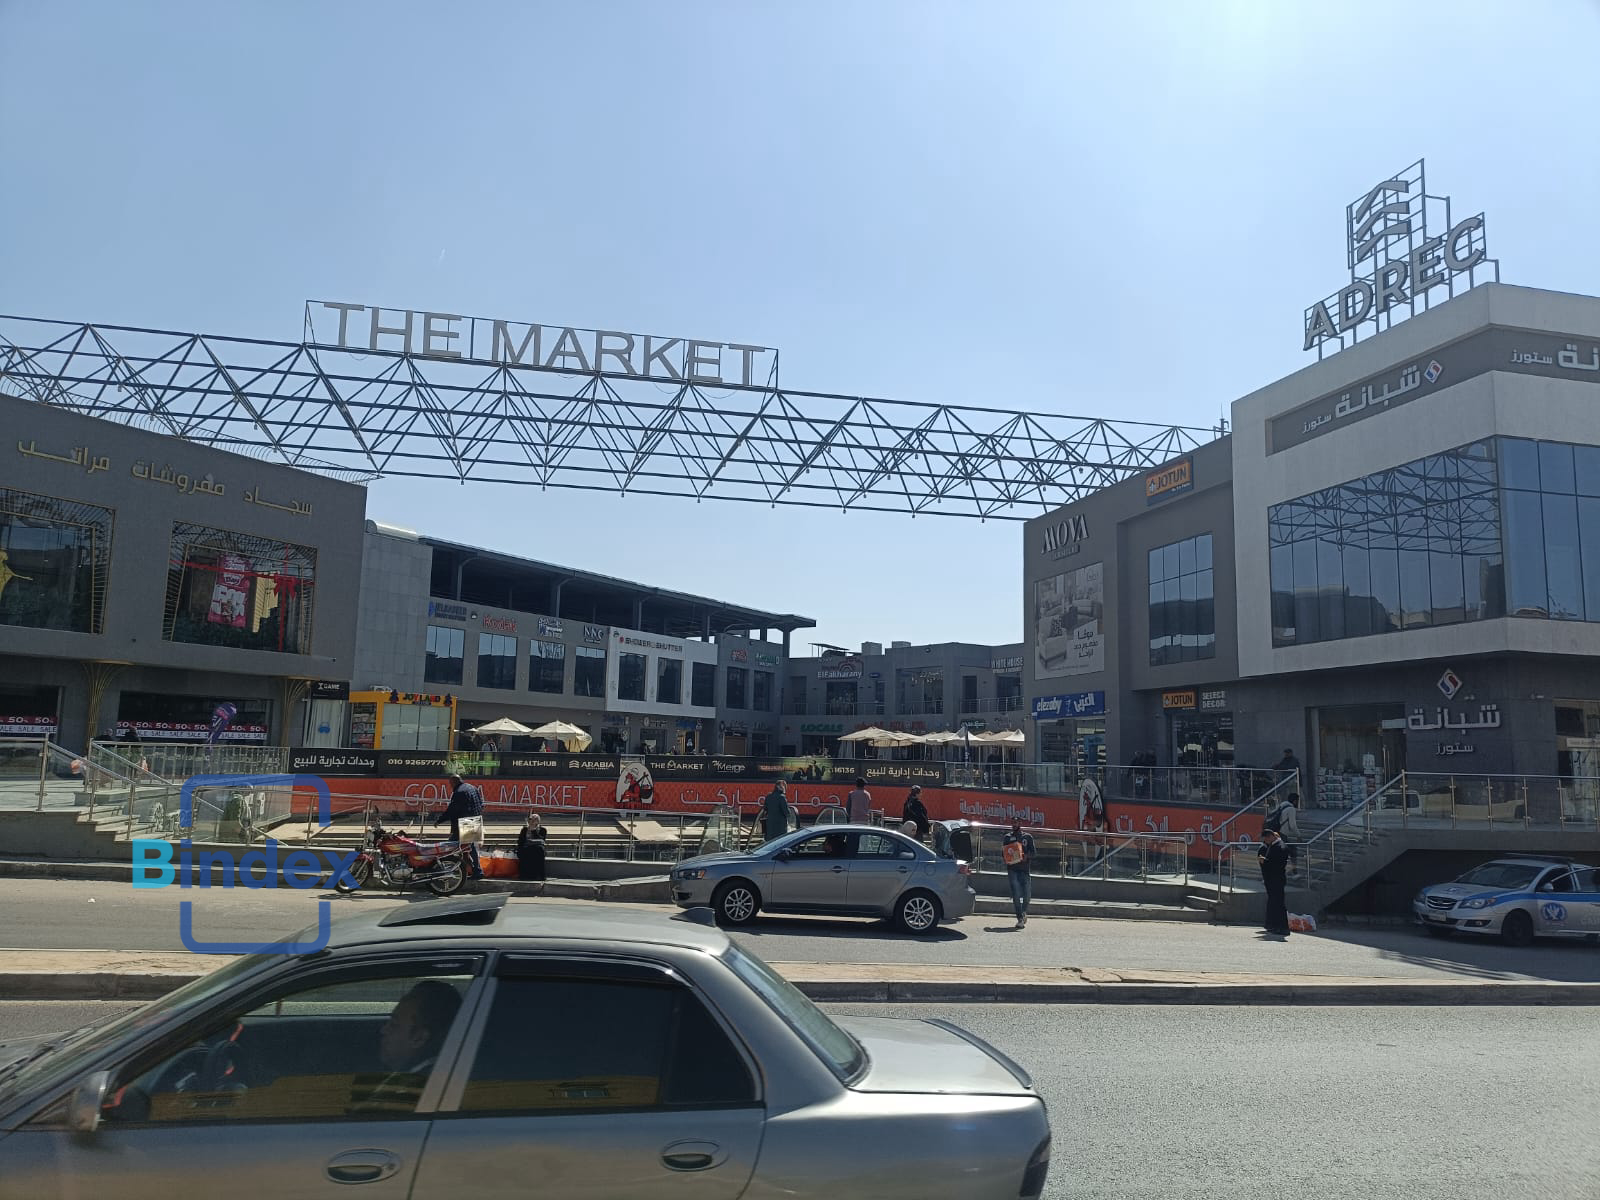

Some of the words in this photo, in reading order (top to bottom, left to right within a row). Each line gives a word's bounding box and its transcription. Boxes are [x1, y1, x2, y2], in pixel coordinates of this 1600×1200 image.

[1303, 217, 1487, 351] ADREC
[324, 301, 462, 358] THE
[492, 319, 766, 386] MARKET
[1511, 348, 1552, 364] ستورز
[1335, 365, 1420, 418] شبانة
[1302, 414, 1332, 434] ستورز
[18, 440, 110, 474] مراتب
[132, 460, 225, 496] مفروشات
[1157, 469, 1187, 492] JOTUN
[244, 486, 312, 515] سجاد
[1171, 695, 1193, 705] JOTUN
[1407, 703, 1501, 734] شبانة
[1436, 742, 1474, 755] ستورز
[294, 755, 317, 768] للبيع
[319, 755, 346, 768] تجارية
[347, 756, 375, 768] وحدات
[666, 760, 705, 770] MARKET
[866, 766, 886, 777] للبيع
[888, 767, 910, 779] إدارية
[912, 767, 940, 779] وحدات
[501, 784, 586, 808] MARKET
